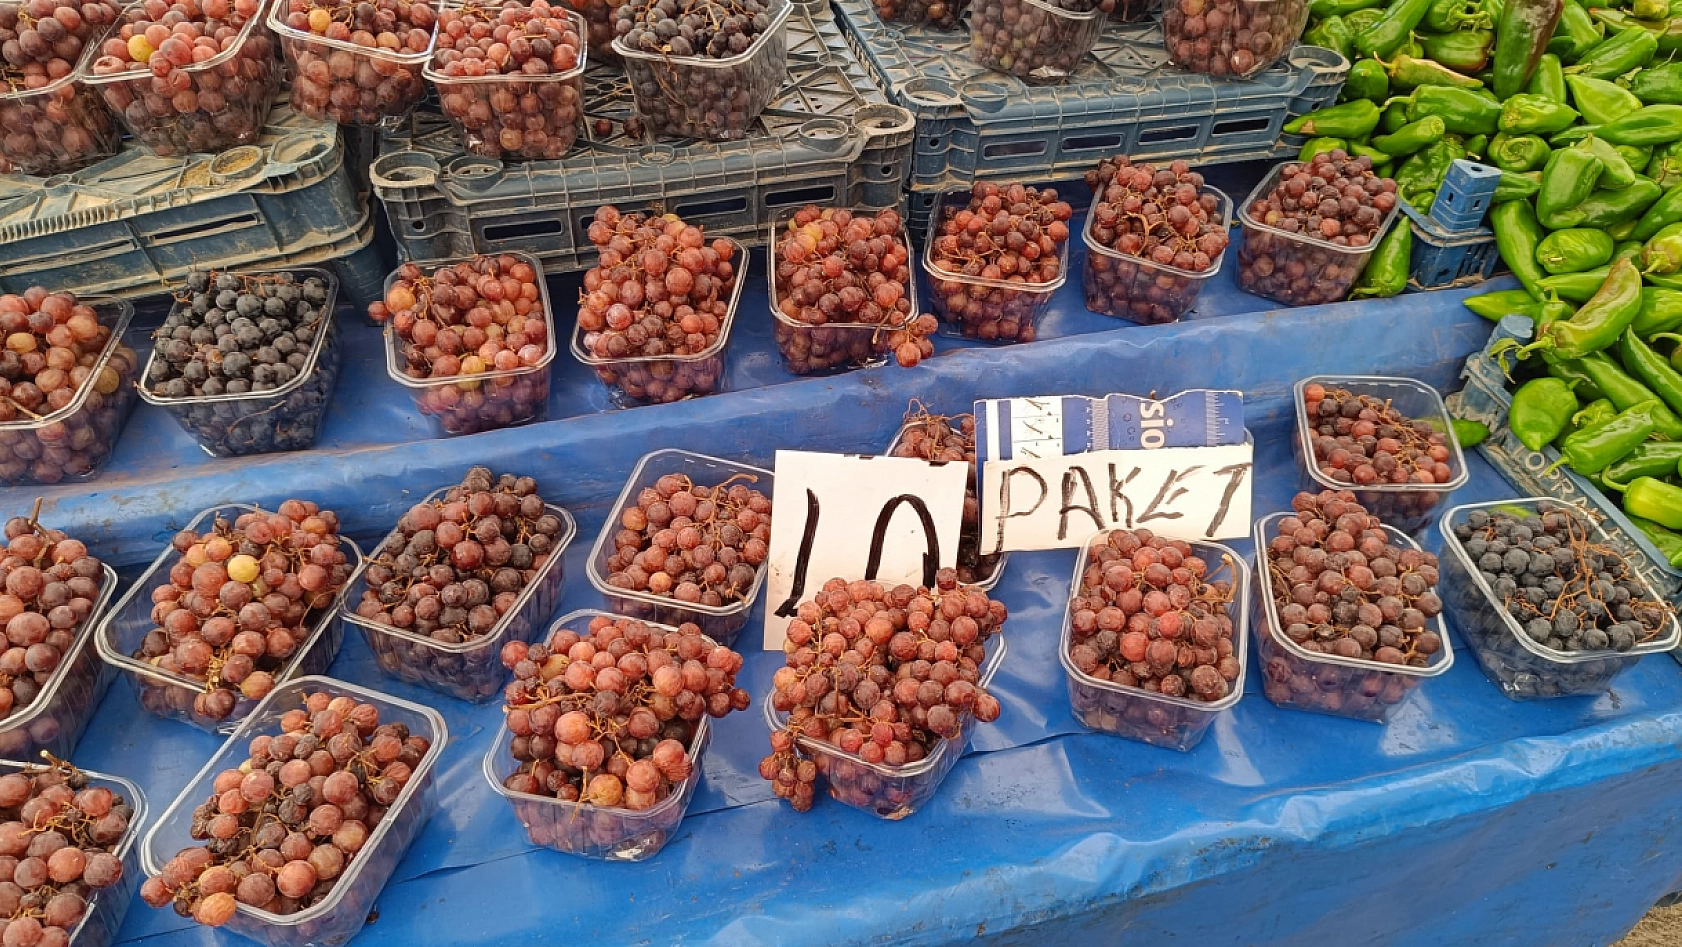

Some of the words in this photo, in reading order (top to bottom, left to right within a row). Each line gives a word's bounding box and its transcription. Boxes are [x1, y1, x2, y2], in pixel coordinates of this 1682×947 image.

[1140, 402, 1175, 450] sio
[773, 488, 940, 618] 10
[995, 462, 1253, 553] PAKET
